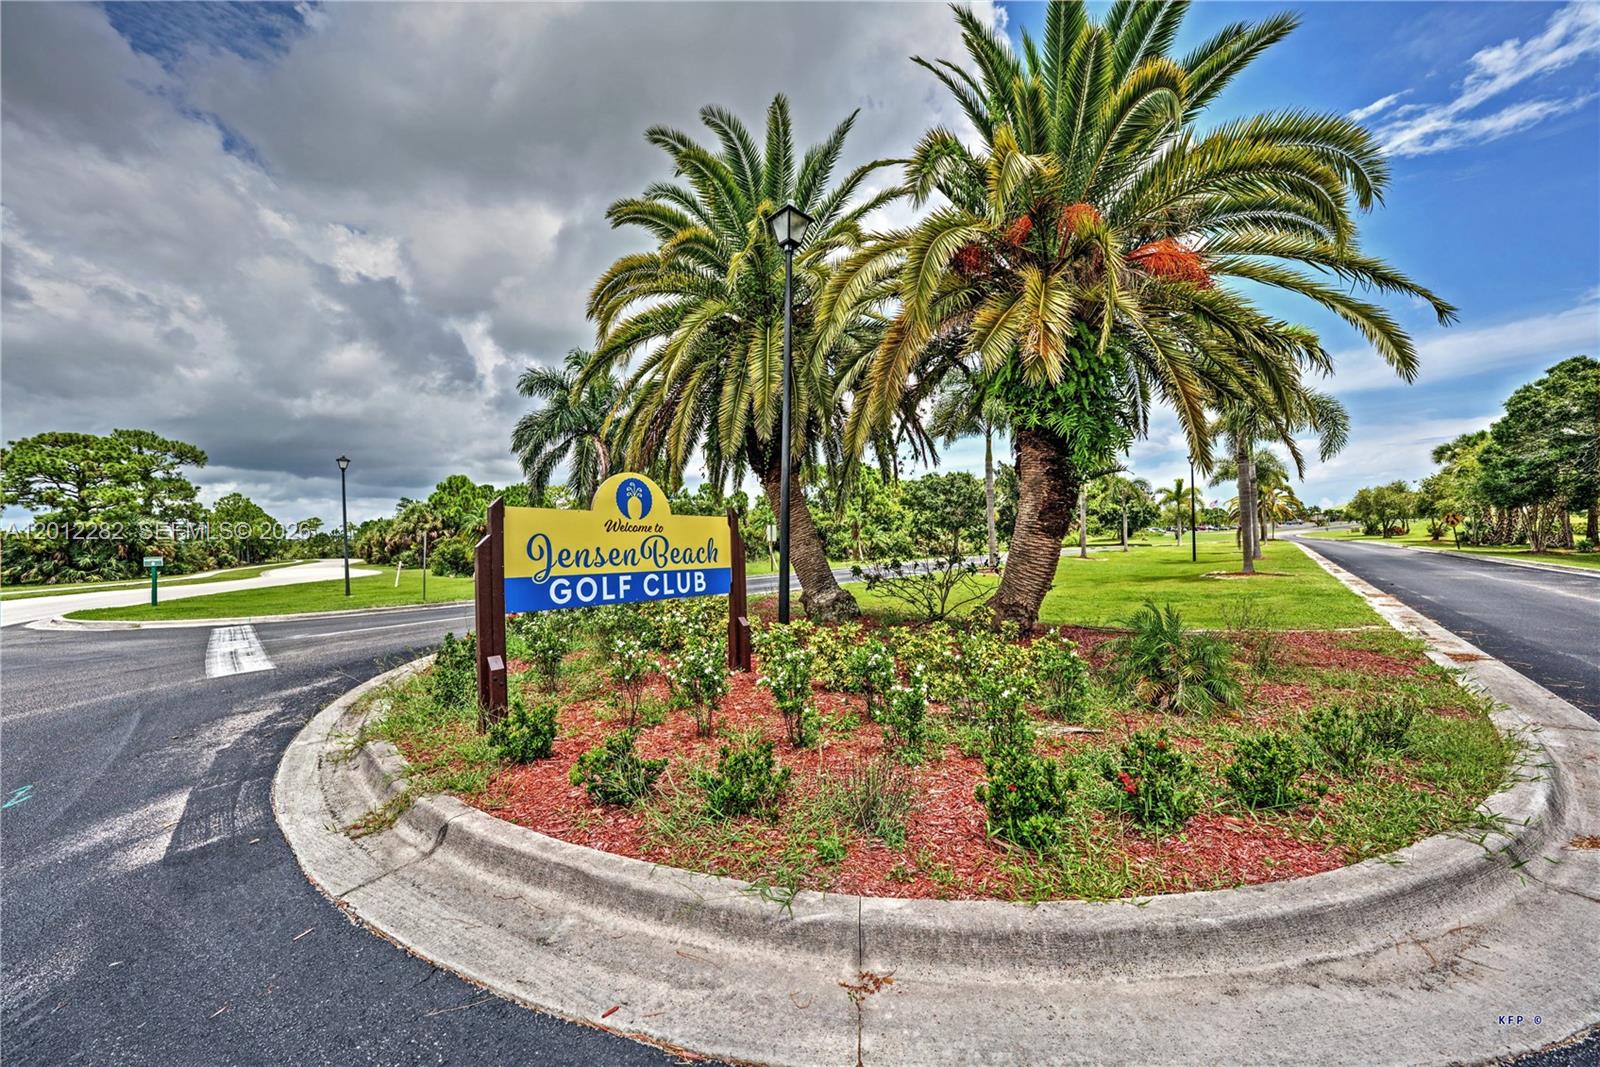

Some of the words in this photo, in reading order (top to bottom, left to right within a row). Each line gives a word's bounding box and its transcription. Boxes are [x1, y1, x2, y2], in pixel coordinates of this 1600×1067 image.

[604, 518, 653, 533] Welcome
[654, 522, 664, 533] to
[526, 533, 639, 584] Jensen
[640, 535, 718, 568] Beach
[549, 575, 632, 605] GOLF
[643, 571, 706, 597] CLUB
